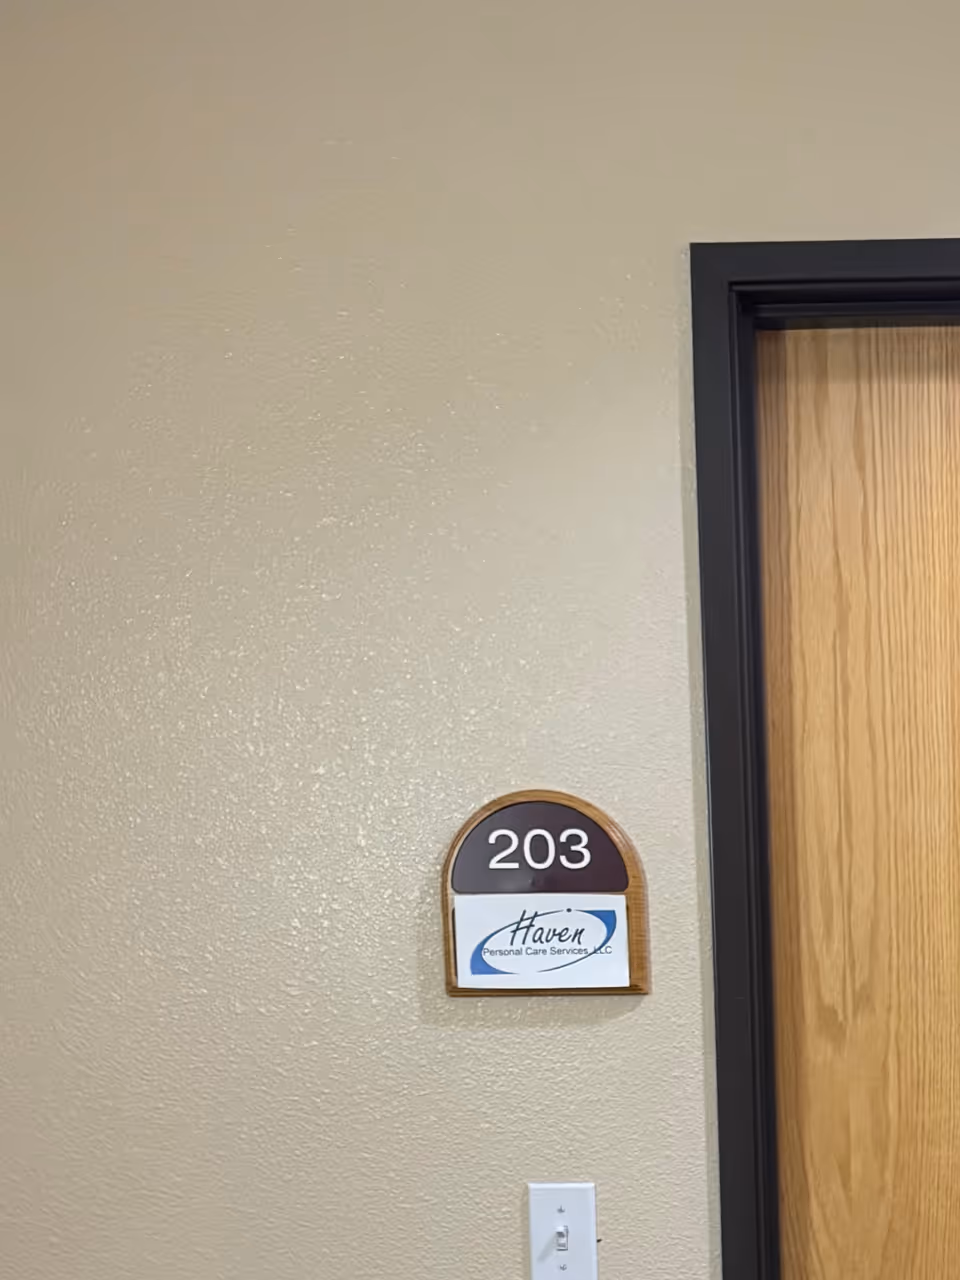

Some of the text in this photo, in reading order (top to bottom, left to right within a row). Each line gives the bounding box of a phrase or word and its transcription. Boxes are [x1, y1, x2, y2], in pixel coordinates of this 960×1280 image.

[487, 828, 592, 870] 203
[509, 909, 586, 946] Haven
[483, 946, 523, 957] Personal
[525, 946, 548, 956] Care
